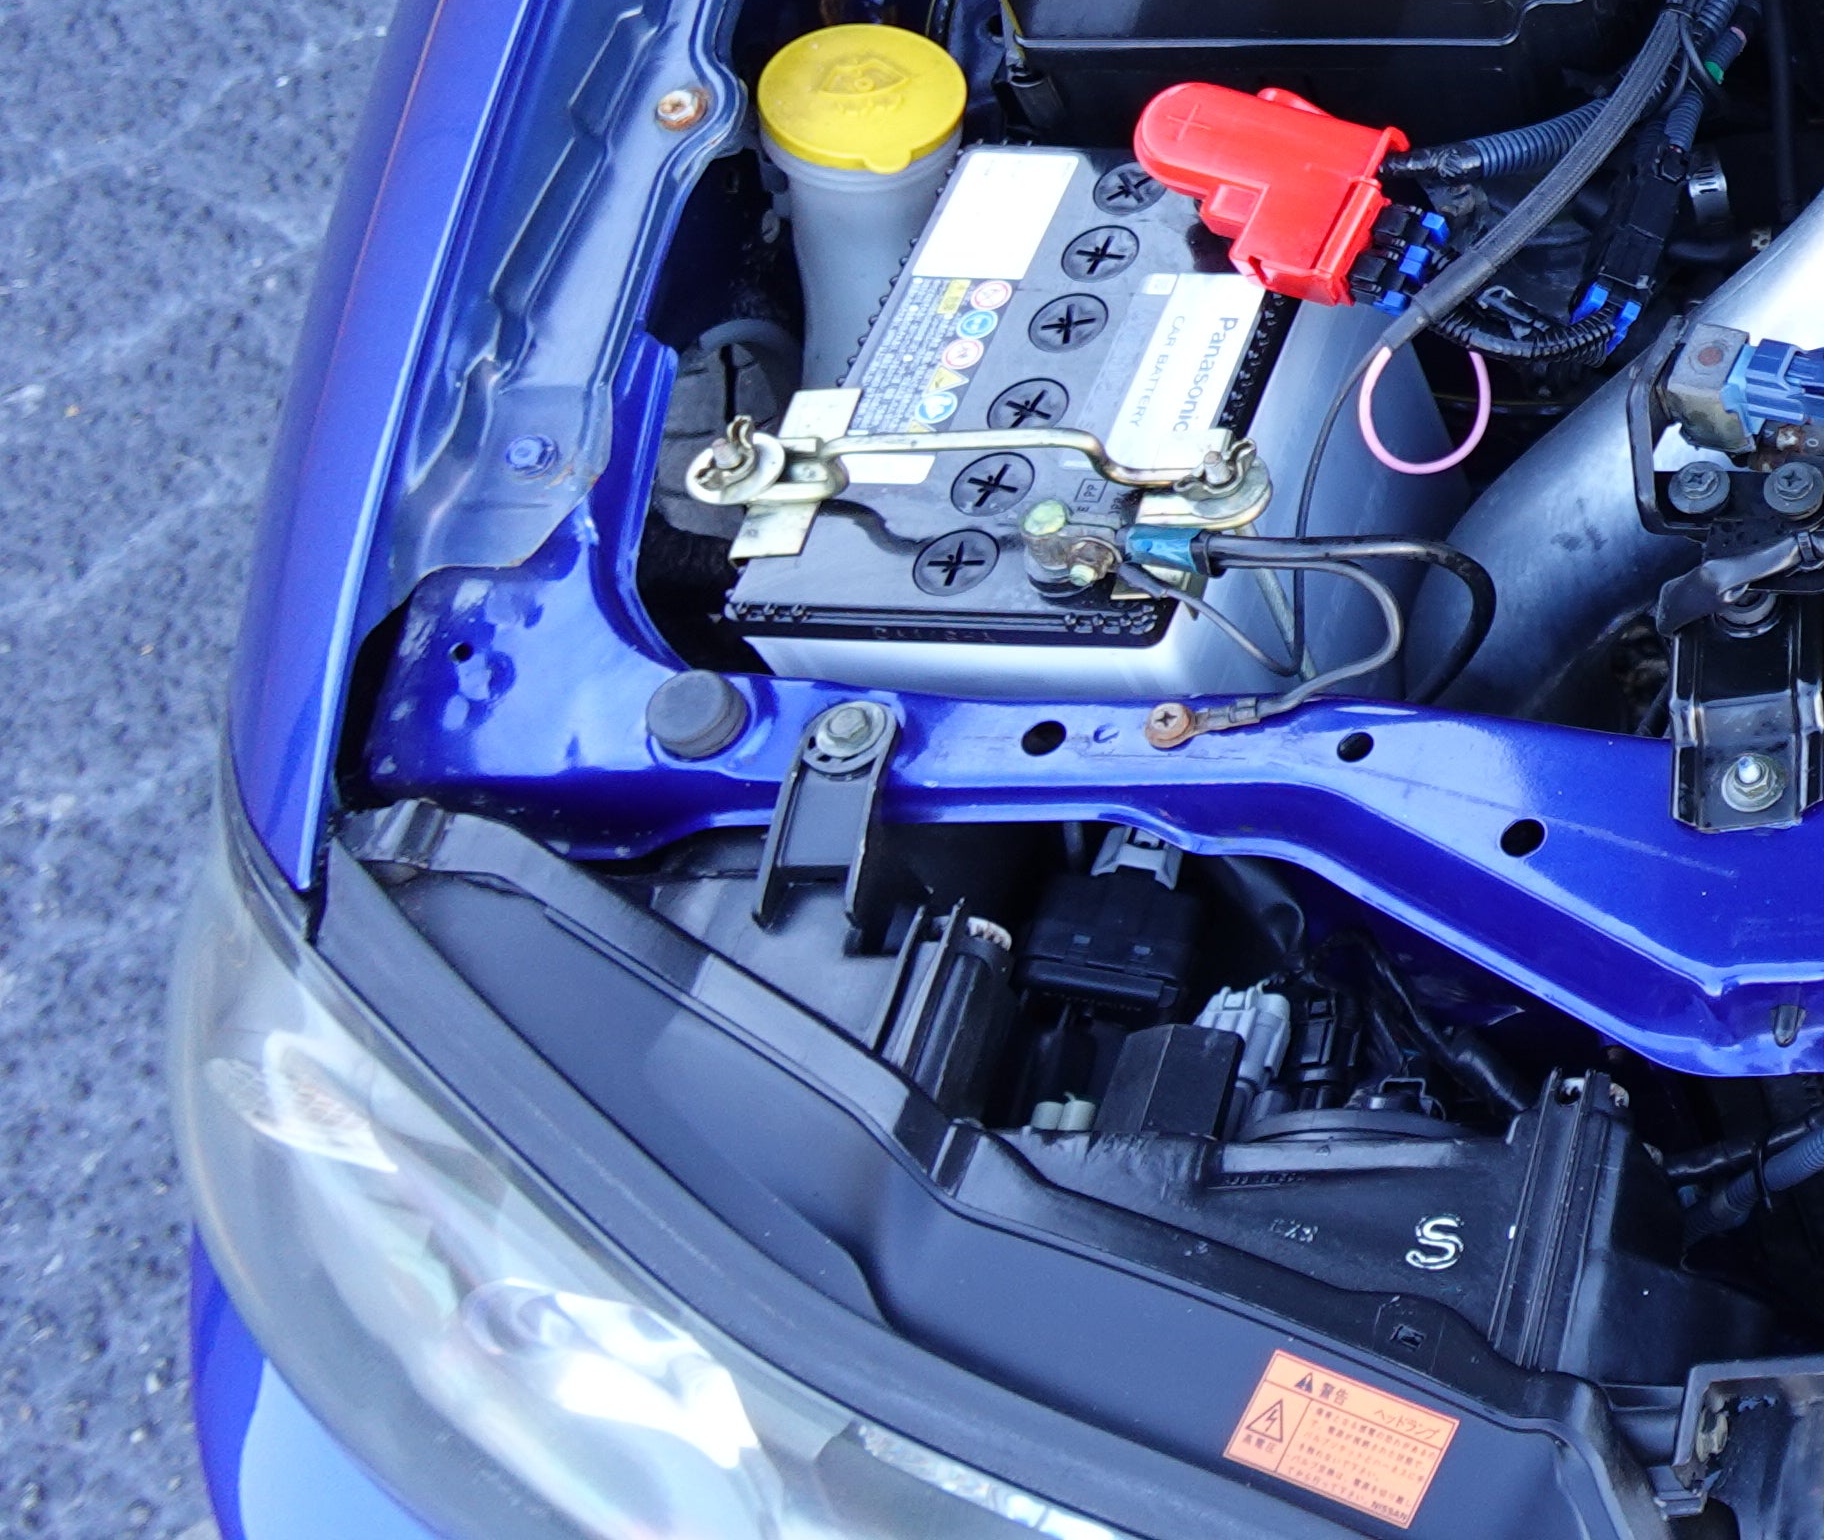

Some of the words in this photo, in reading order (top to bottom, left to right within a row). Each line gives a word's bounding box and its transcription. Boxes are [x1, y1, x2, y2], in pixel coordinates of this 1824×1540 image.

[1165, 315, 1185, 346] CAR
[1130, 354, 1169, 427] BATTERY
[1173, 316, 1239, 432] Panasonic
[1369, 1499, 1408, 1521] NISSAN
